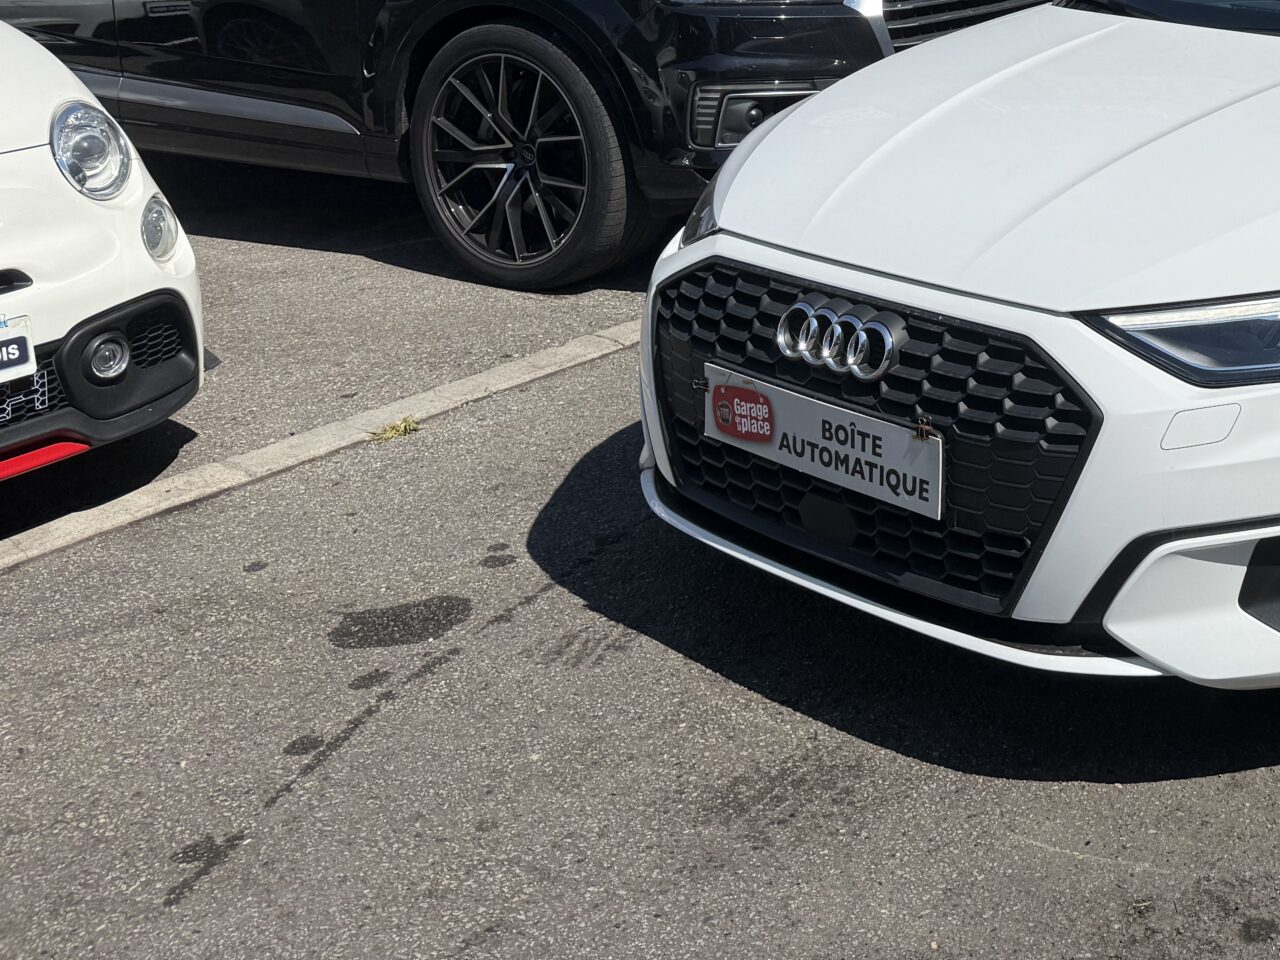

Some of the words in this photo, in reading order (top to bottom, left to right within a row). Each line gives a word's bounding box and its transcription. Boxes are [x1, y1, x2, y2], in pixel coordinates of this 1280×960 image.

[733, 398, 769, 420] Garage
[742, 416, 771, 436] place
[820, 419, 883, 458] BOÎTE
[778, 432, 930, 503] AUTOMATIQUE
